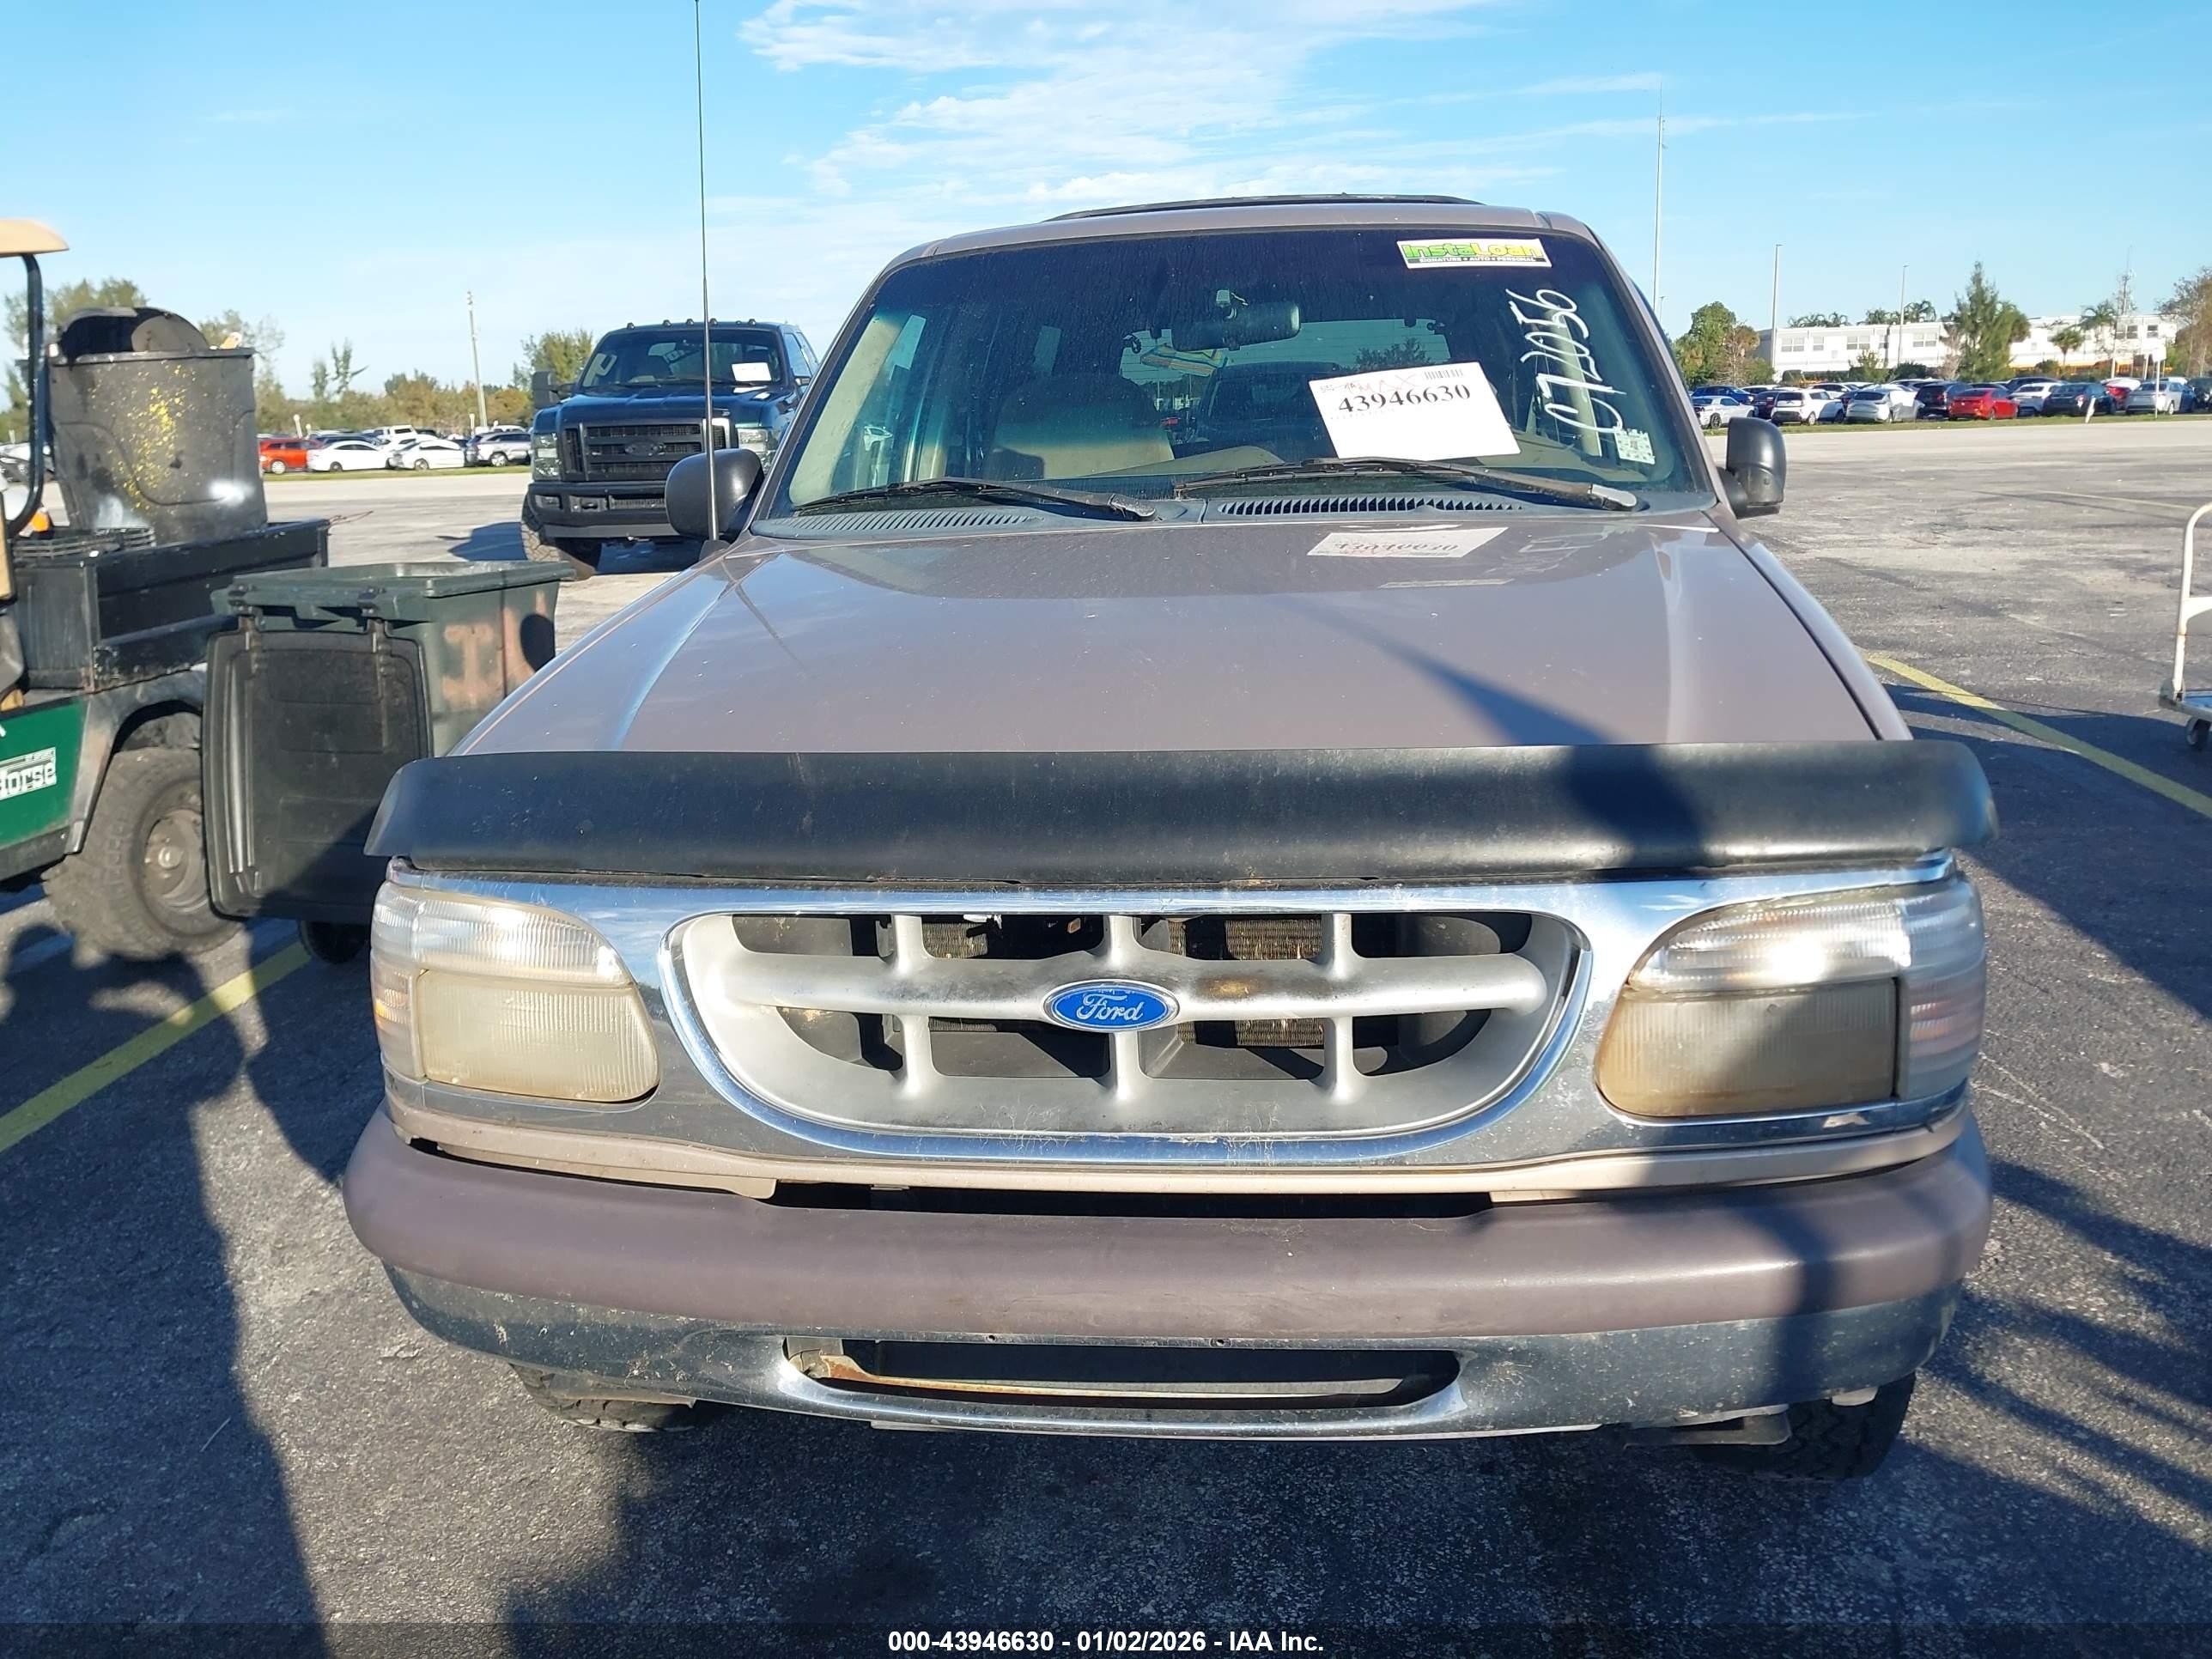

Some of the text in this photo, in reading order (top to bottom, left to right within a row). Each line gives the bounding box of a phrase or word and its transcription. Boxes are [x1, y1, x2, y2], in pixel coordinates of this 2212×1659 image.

[1401, 242, 1544, 258] InstaLoan
[1339, 385, 1470, 412] 43946630
[1076, 993, 1144, 1021] Ford
